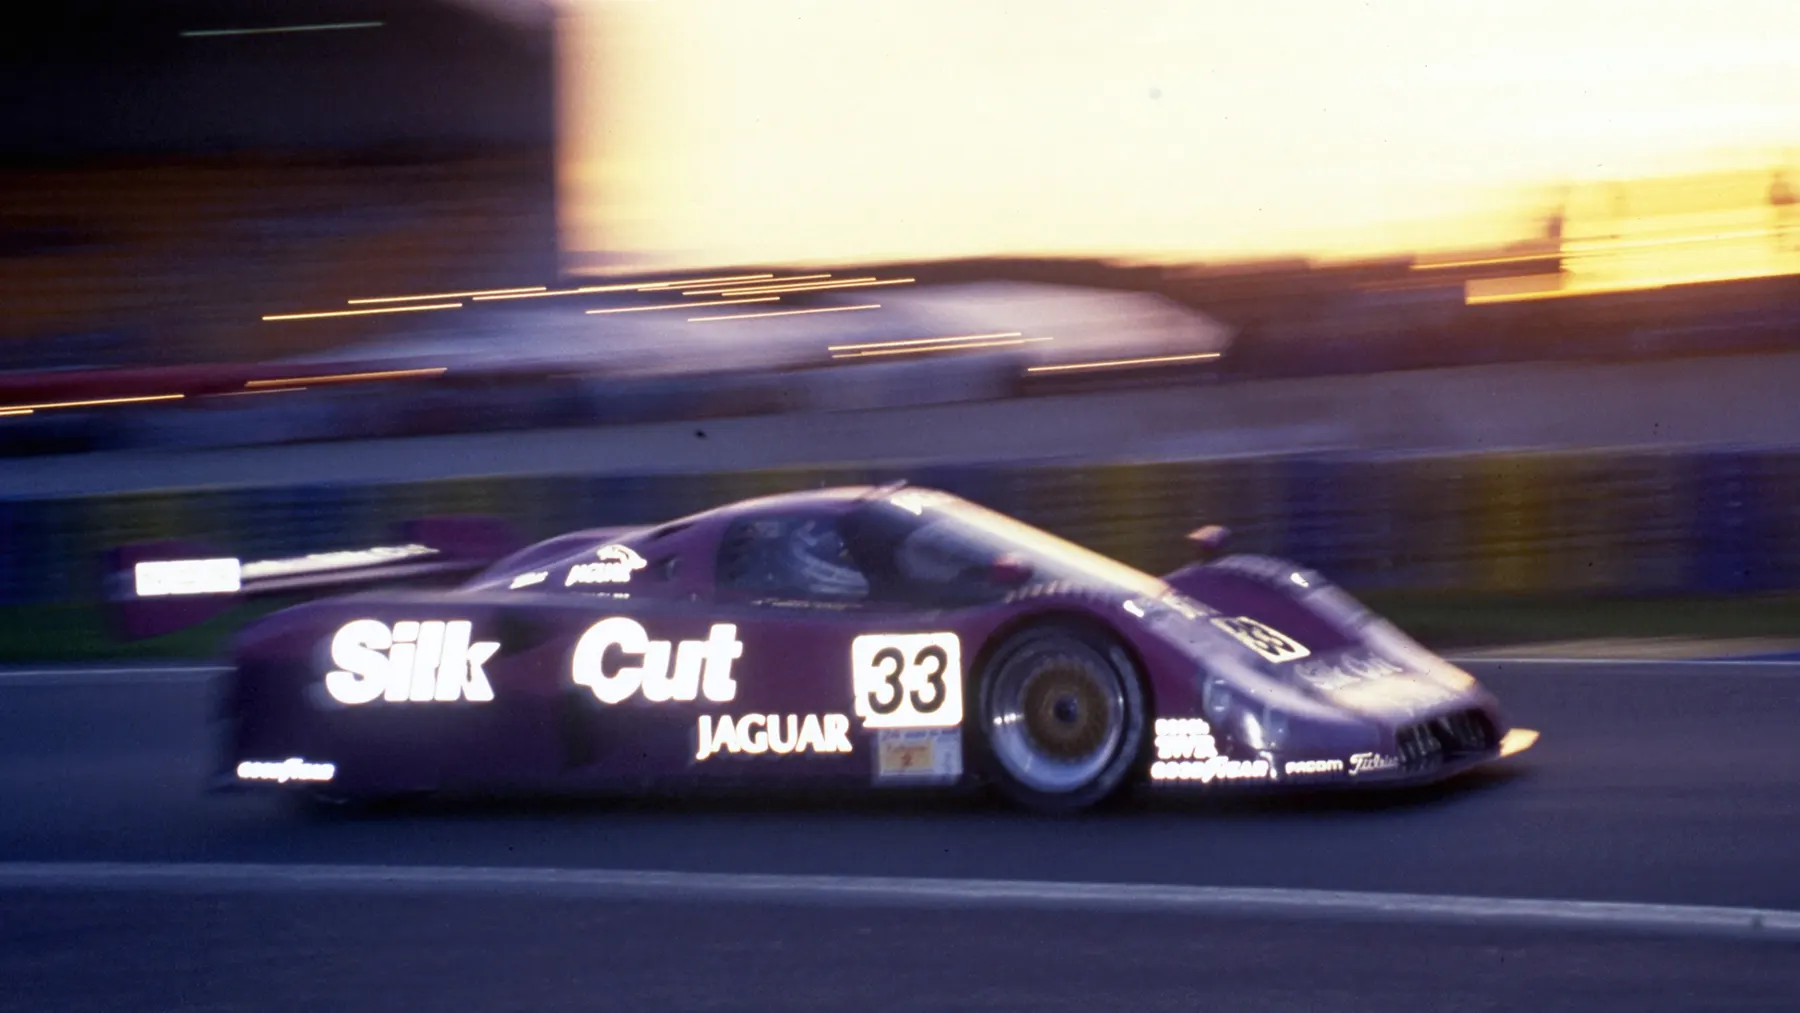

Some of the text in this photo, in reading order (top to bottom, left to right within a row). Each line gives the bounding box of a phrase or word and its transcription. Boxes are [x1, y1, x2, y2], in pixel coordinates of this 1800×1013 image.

[325, 616, 743, 704] Silk Cut
[868, 644, 948, 714] 33
[696, 713, 852, 760] JAGUAR
